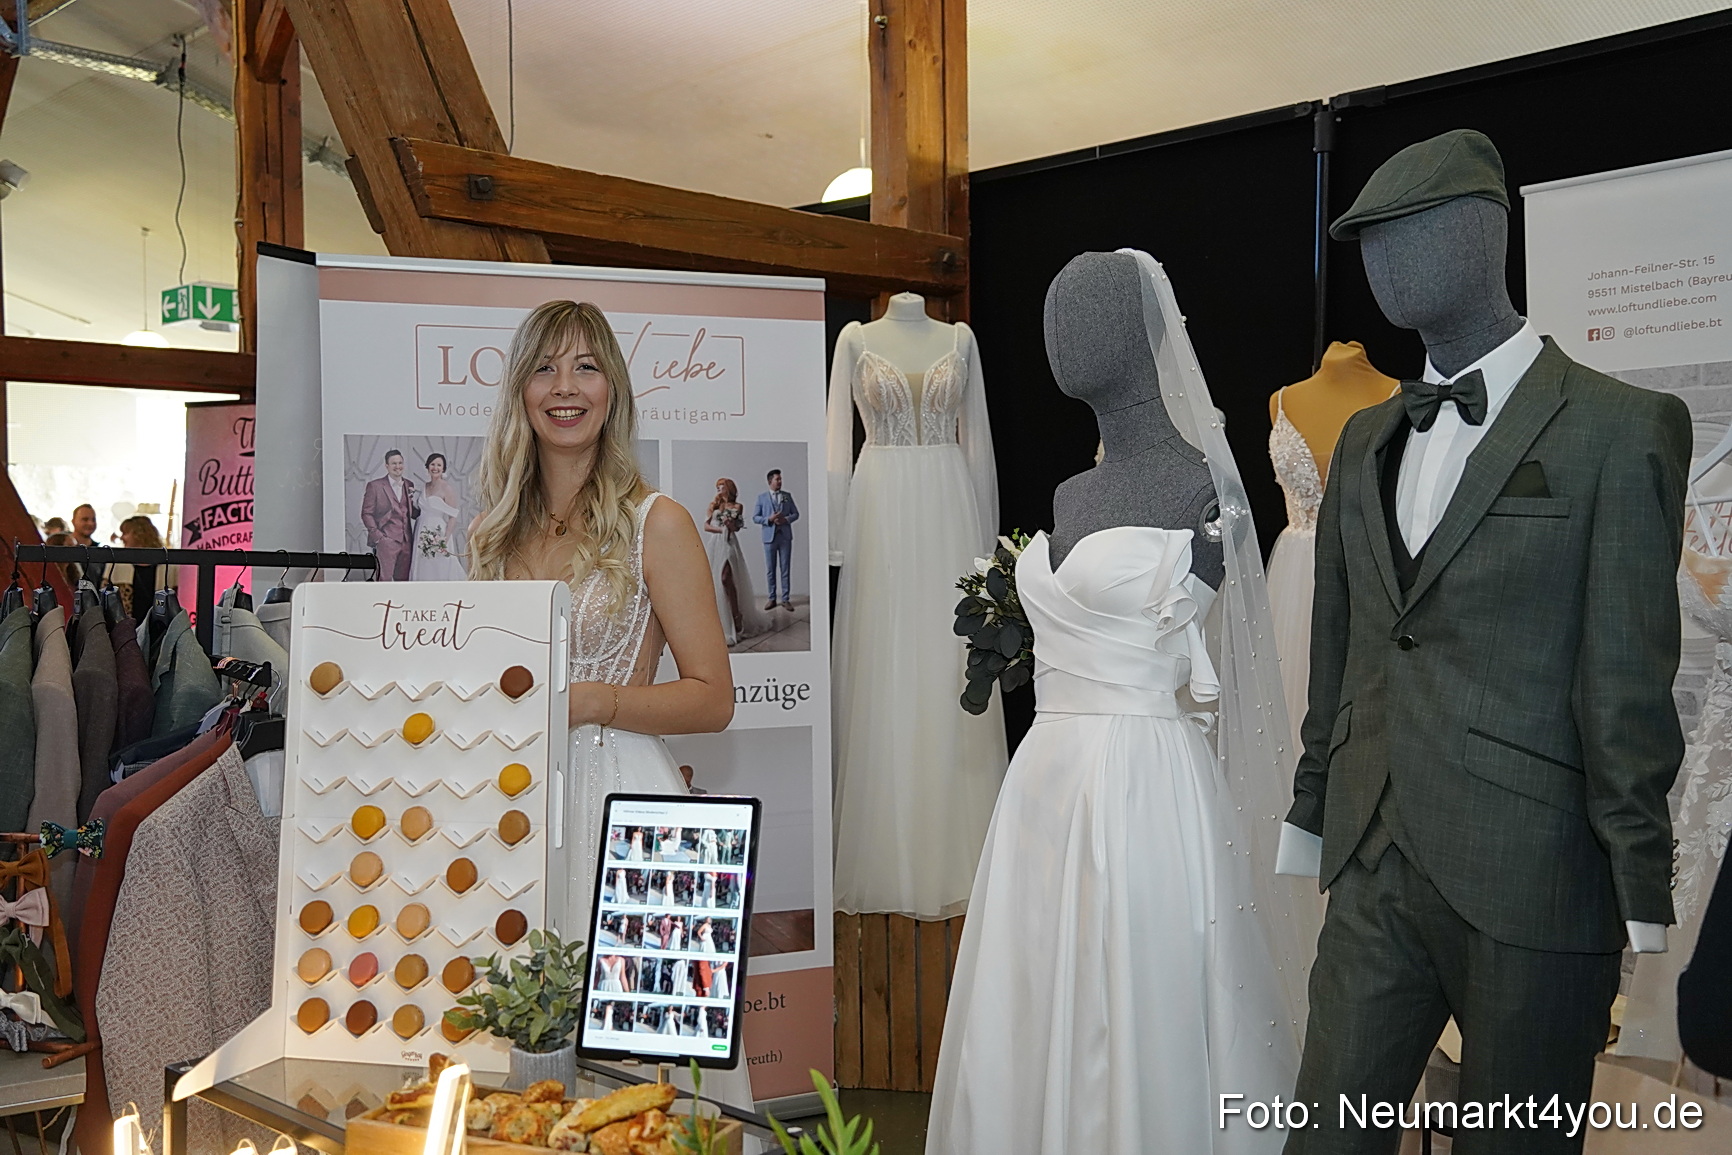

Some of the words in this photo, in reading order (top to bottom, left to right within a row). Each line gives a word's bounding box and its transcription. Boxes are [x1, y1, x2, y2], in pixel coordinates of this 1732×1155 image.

[1587, 258, 1699, 281] Johann-Feilner-Str.
[1702, 254, 1716, 266] 15
[1587, 287, 1617, 299] 95511
[1620, 277, 1684, 295] Mistelbach
[1587, 293, 1718, 317] www.loftundliebe.com
[1623, 317, 1723, 339] @loftundliebe.bt
[633, 321, 726, 399] Liebe
[437, 402, 492, 417] Mode
[637, 405, 728, 424] räutigam
[373, 599, 476, 651] treat
[402, 609, 437, 622] TAKE
[441, 610, 450, 622] A
[733, 677, 811, 710] nzüge
[746, 1049, 783, 1066] reuth)
